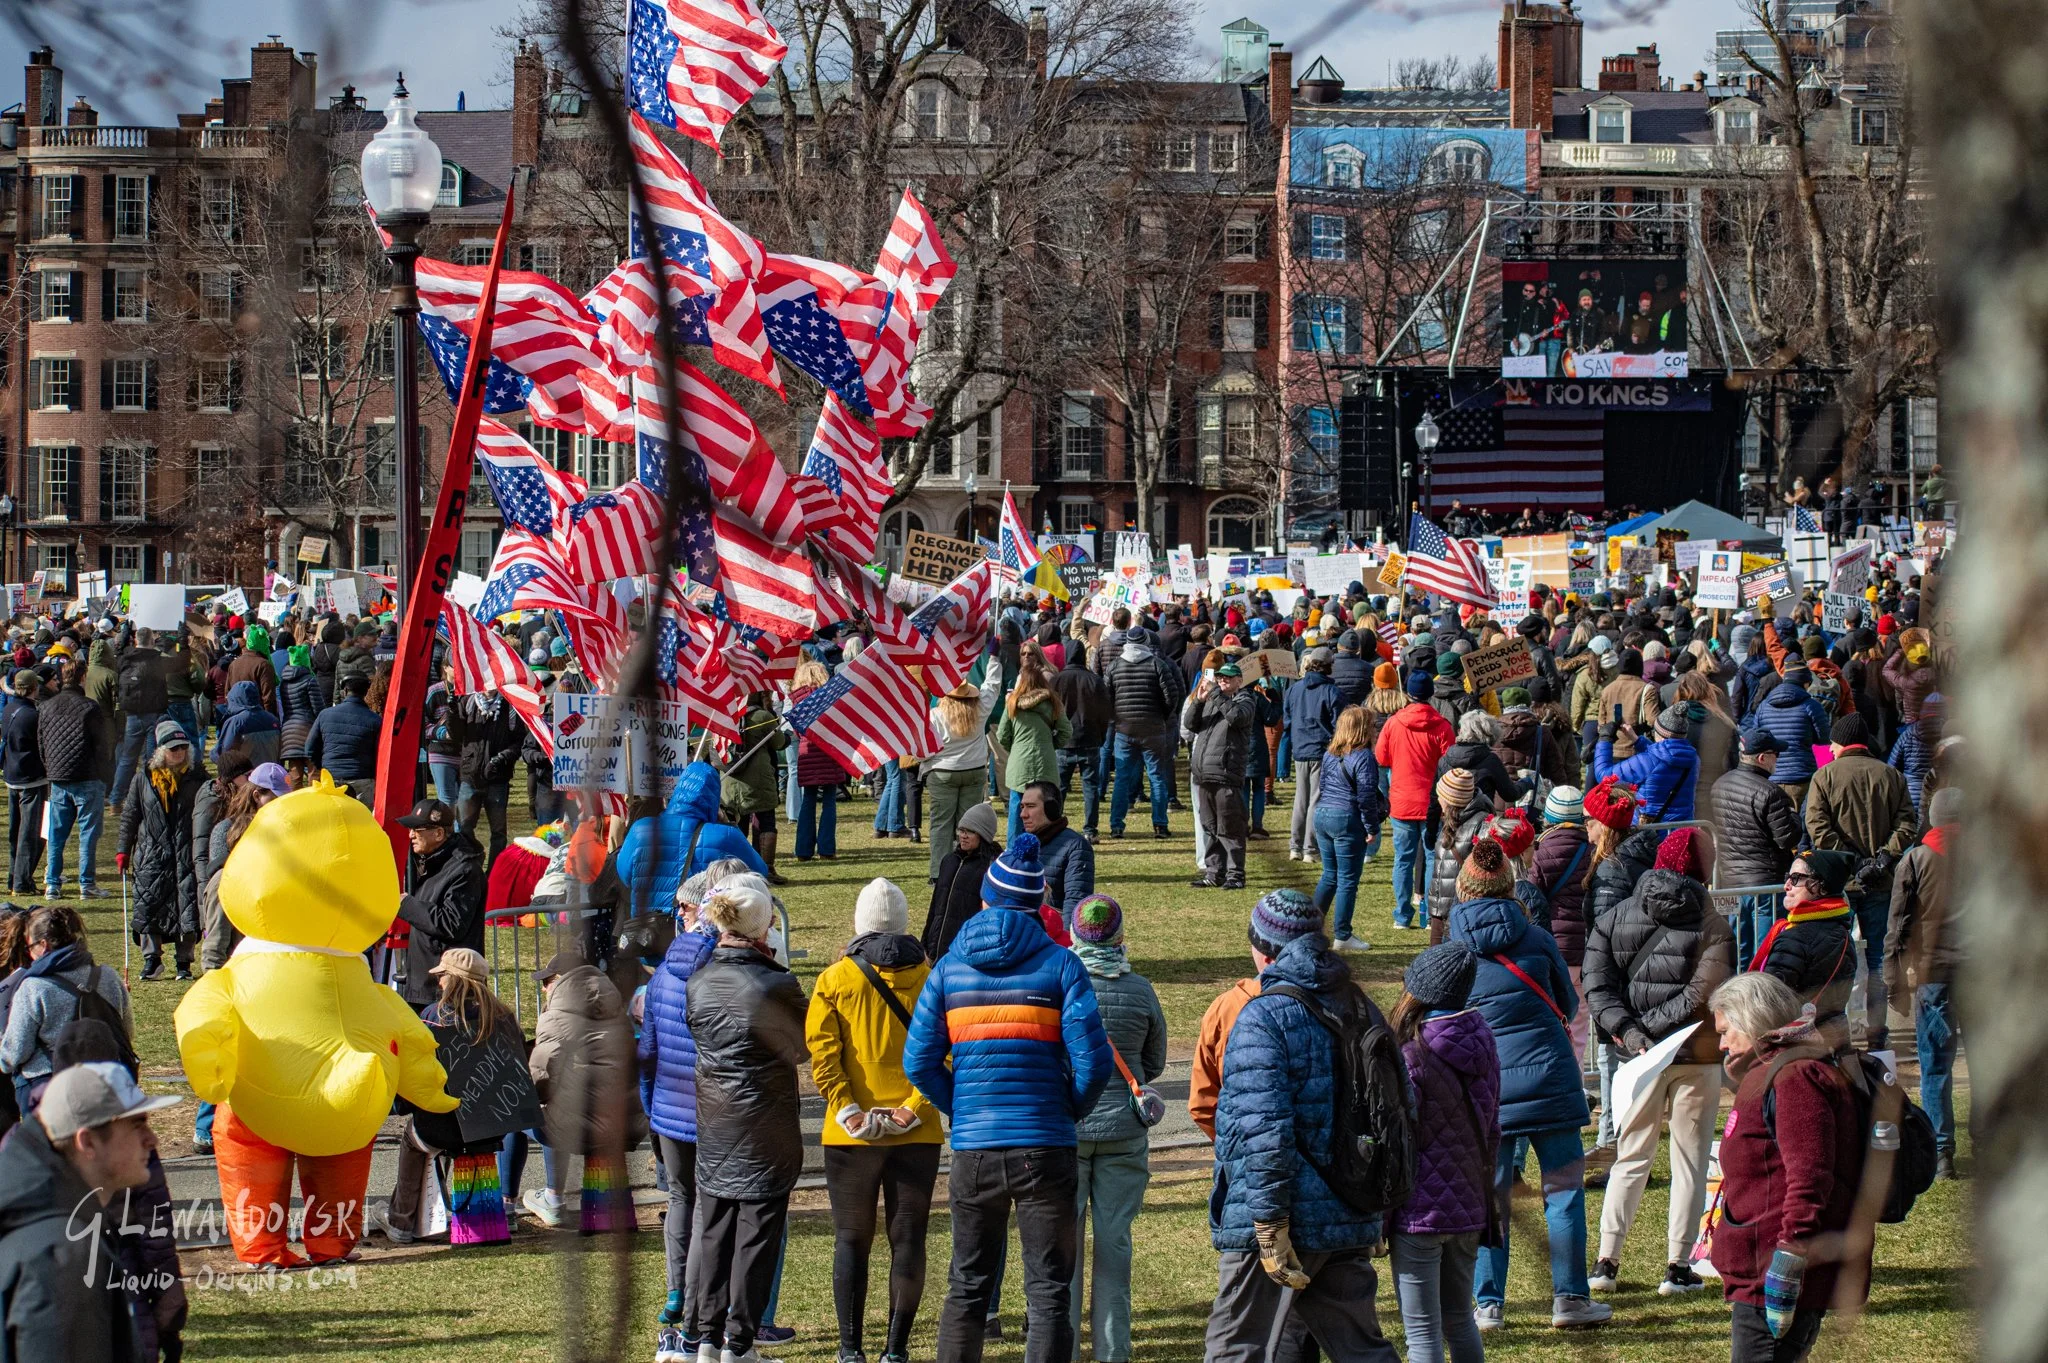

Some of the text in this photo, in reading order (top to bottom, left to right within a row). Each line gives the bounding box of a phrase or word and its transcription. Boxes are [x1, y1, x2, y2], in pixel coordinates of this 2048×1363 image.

[1546, 385, 1669, 406] NO KINGS
[914, 533, 982, 558] REGIME
[1064, 565, 1097, 576] NO WAR
[1178, 568, 1188, 576] NO
[1740, 565, 1786, 585] NO KINGS IN
[1069, 576, 1081, 585] NO
[1175, 576, 1193, 584] KINGS
[1381, 573, 1398, 586] 1776
[1700, 575, 1738, 584] IMPEACH
[1089, 580, 1140, 605] PEOPLE
[1501, 592, 1517, 602] NO
[1699, 593, 1736, 601] PROSECUTE
[1746, 586, 1792, 607] AMRICA
[1101, 597, 1126, 610] OVER
[1495, 602, 1527, 611] ctators
[1824, 594, 1871, 610] WILL TRADE
[1466, 640, 1525, 668] DEMOCRACY
[1472, 651, 1532, 678] NEEDS YOUR
[1475, 662, 1533, 689] COURAGE
[568, 695, 612, 715] LEFT
[636, 700, 681, 721] RIGHT
[560, 715, 583, 735] STOP
